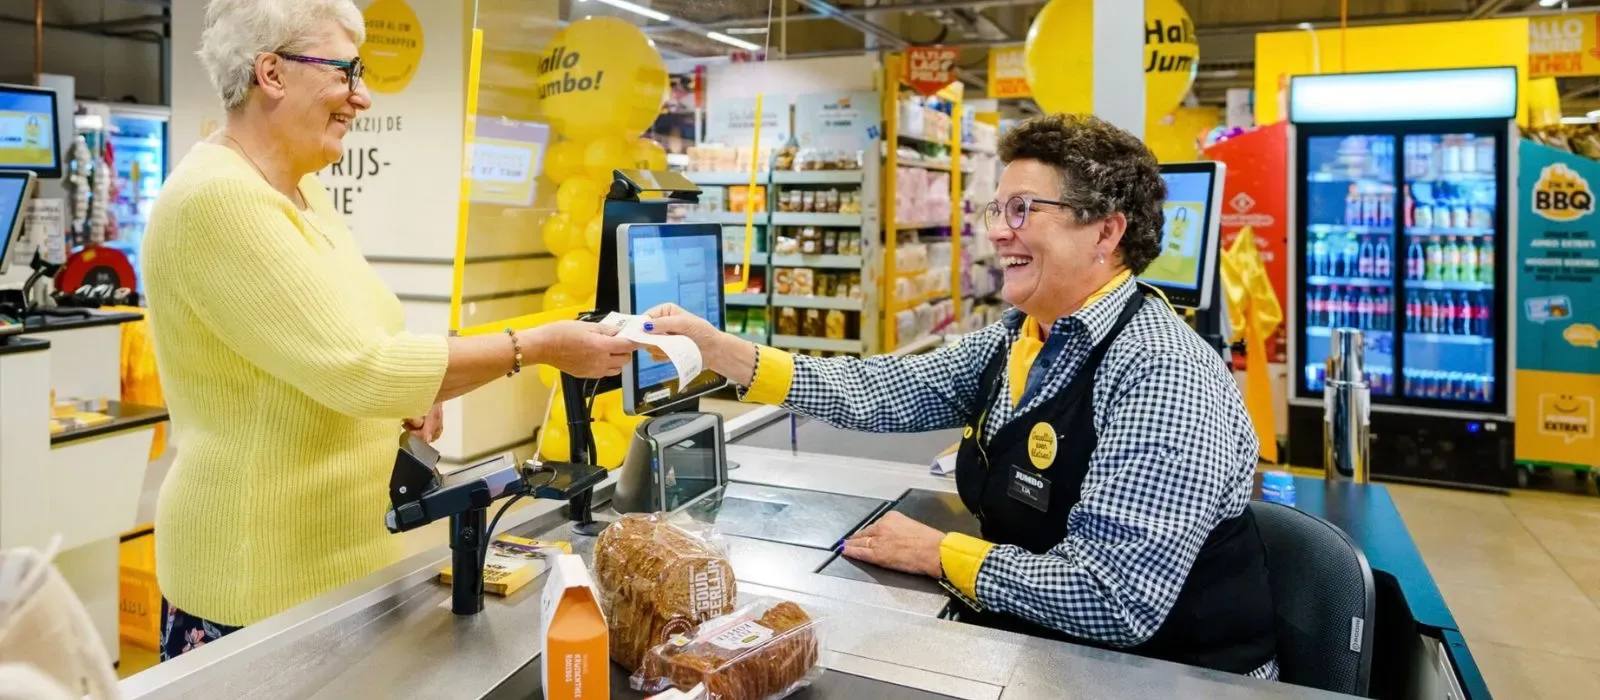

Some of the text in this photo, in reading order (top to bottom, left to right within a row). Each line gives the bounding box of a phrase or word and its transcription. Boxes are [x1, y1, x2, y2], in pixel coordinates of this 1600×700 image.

[386, 116, 402, 131] DE
[316, 148, 391, 180] RIJS-
[1536, 190, 1591, 211] BBQ
[1015, 471, 1044, 489] JUMBO
[695, 571, 710, 612] GOUD
[707, 560, 722, 619] EERLIJK
[565, 654, 573, 682] ROOIBOS
[574, 654, 582, 698] KRUIDENTHEE
